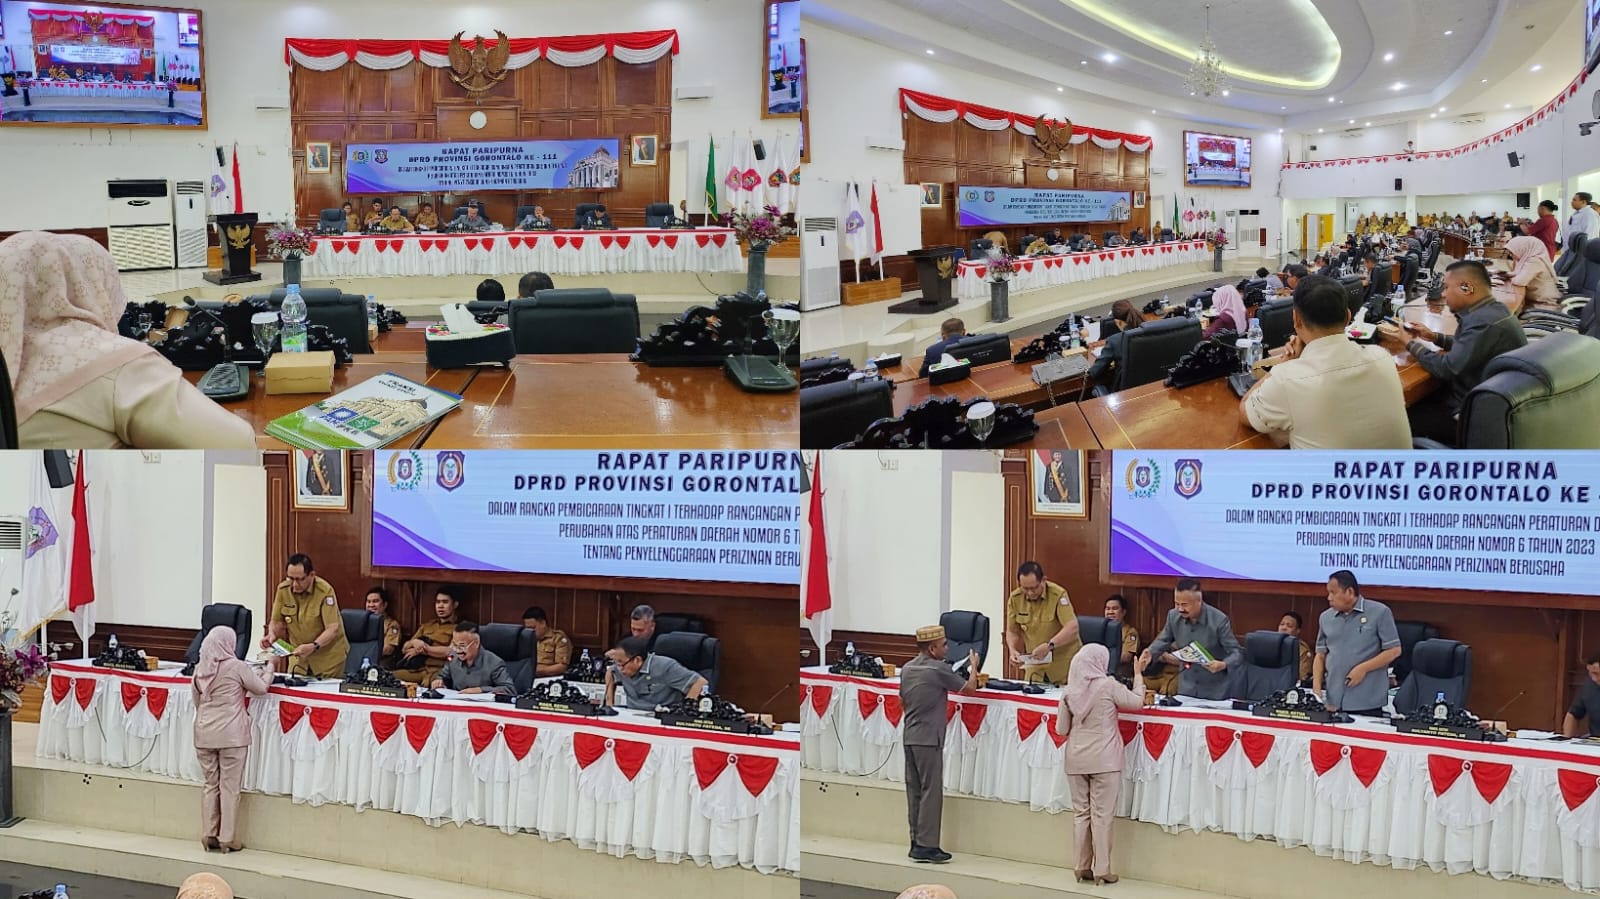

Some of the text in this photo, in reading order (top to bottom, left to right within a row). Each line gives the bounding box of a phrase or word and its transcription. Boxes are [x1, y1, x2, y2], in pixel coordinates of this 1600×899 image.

[597, 452, 800, 471] RAPAT PARIPURN
[1333, 461, 1557, 480] RAPAT PARIPURNA
[514, 475, 800, 493] DPRD PROVINSI GORONTAL
[1251, 483, 1590, 503] DPRD PROVINSI GORONTALO KE
[488, 501, 517, 516] DALAM
[519, 501, 556, 517] RANGKA
[558, 502, 623, 519] PEMBICARAAN
[626, 503, 665, 519] TINGKAT
[674, 504, 724, 520] TERHADAP
[727, 505, 791, 522] RANCANGAN
[1225, 509, 1254, 523] DALAM
[1257, 509, 1293, 525] RANGKA
[1295, 510, 1360, 527] PEMBICARAAN
[1363, 511, 1400, 527] TINGKAT
[1410, 512, 1460, 529] TERHADAP
[1462, 513, 1526, 530] RANCANGAN
[1529, 514, 1590, 532] PERATURAN
[559, 523, 613, 539] PERUBAHAN
[615, 524, 639, 540] ATAS
[642, 525, 698, 542] PERATURAN
[701, 526, 740, 543] DAERAH
[743, 527, 780, 544] NOMOR
[783, 528, 791, 544] 6
[1296, 531, 1595, 555] PERUBAHAN ATAS PERATURAN DAERAH NOMOR 6 TAHUN 2023
[583, 544, 800, 567] TENTANG PENYELENGGARAAN PERIZINAN BERU
[1320, 552, 1565, 576] TENTANG PENYELENGGARAAN PERIZINAN BERUSAHA
